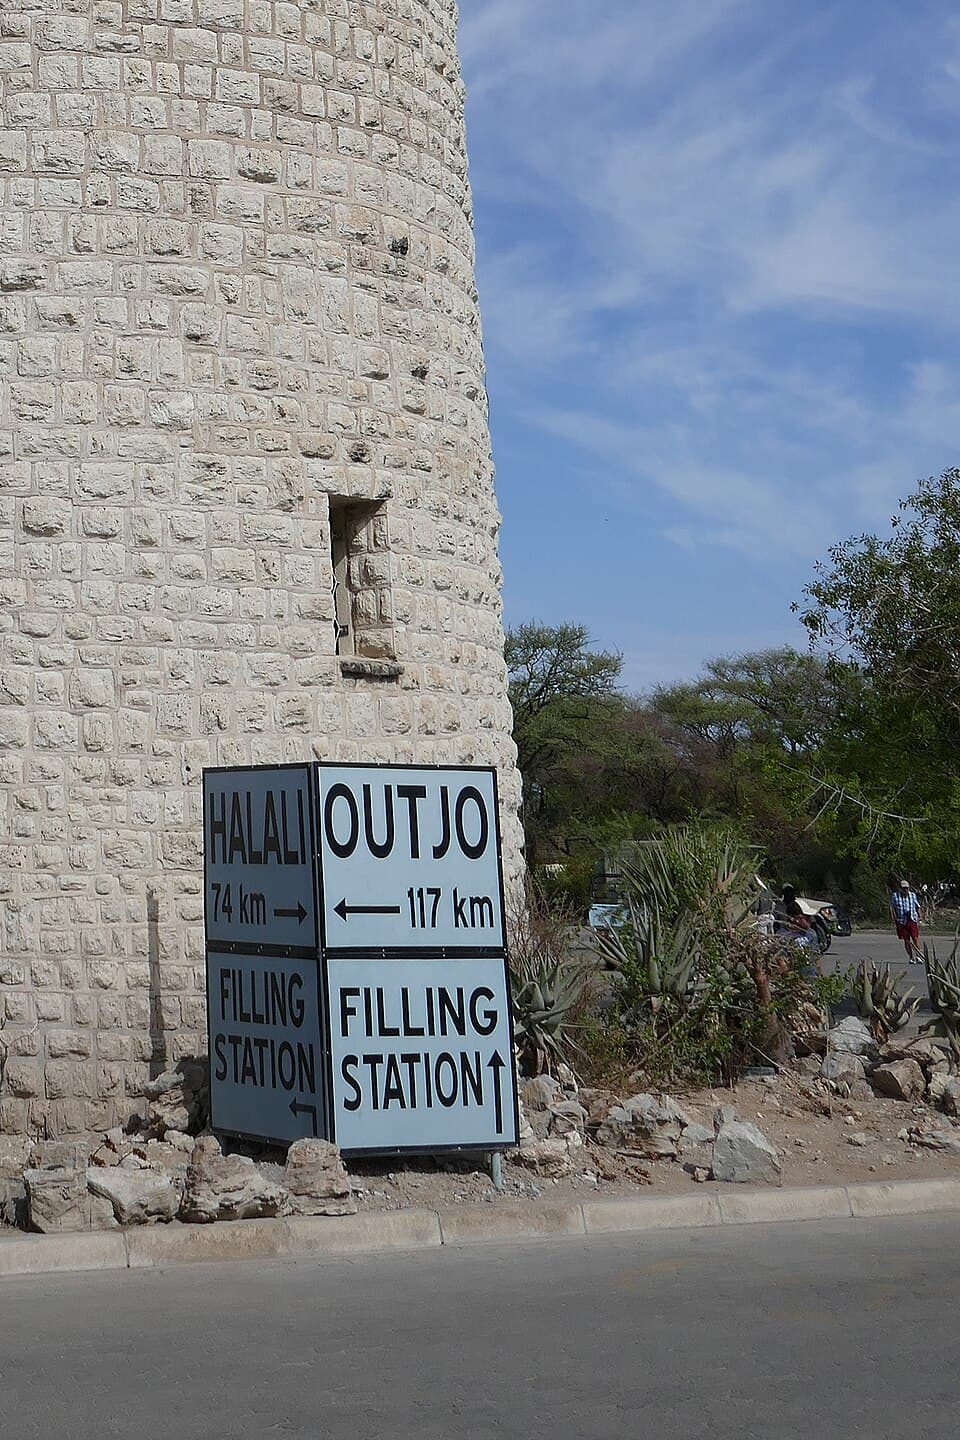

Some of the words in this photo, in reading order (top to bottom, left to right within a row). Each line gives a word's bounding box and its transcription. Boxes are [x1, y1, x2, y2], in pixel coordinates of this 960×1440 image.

[209, 789, 305, 865] HALALI
[324, 782, 489, 860] OUTJO
[211, 883, 233, 923] 74
[239, 882, 267, 925] km
[407, 887, 441, 929] 117
[453, 887, 494, 928] km
[220, 968, 305, 1028] FILLING
[339, 986, 498, 1037] FILLING
[215, 1033, 316, 1094] STATION
[341, 1050, 484, 1111] STATION
